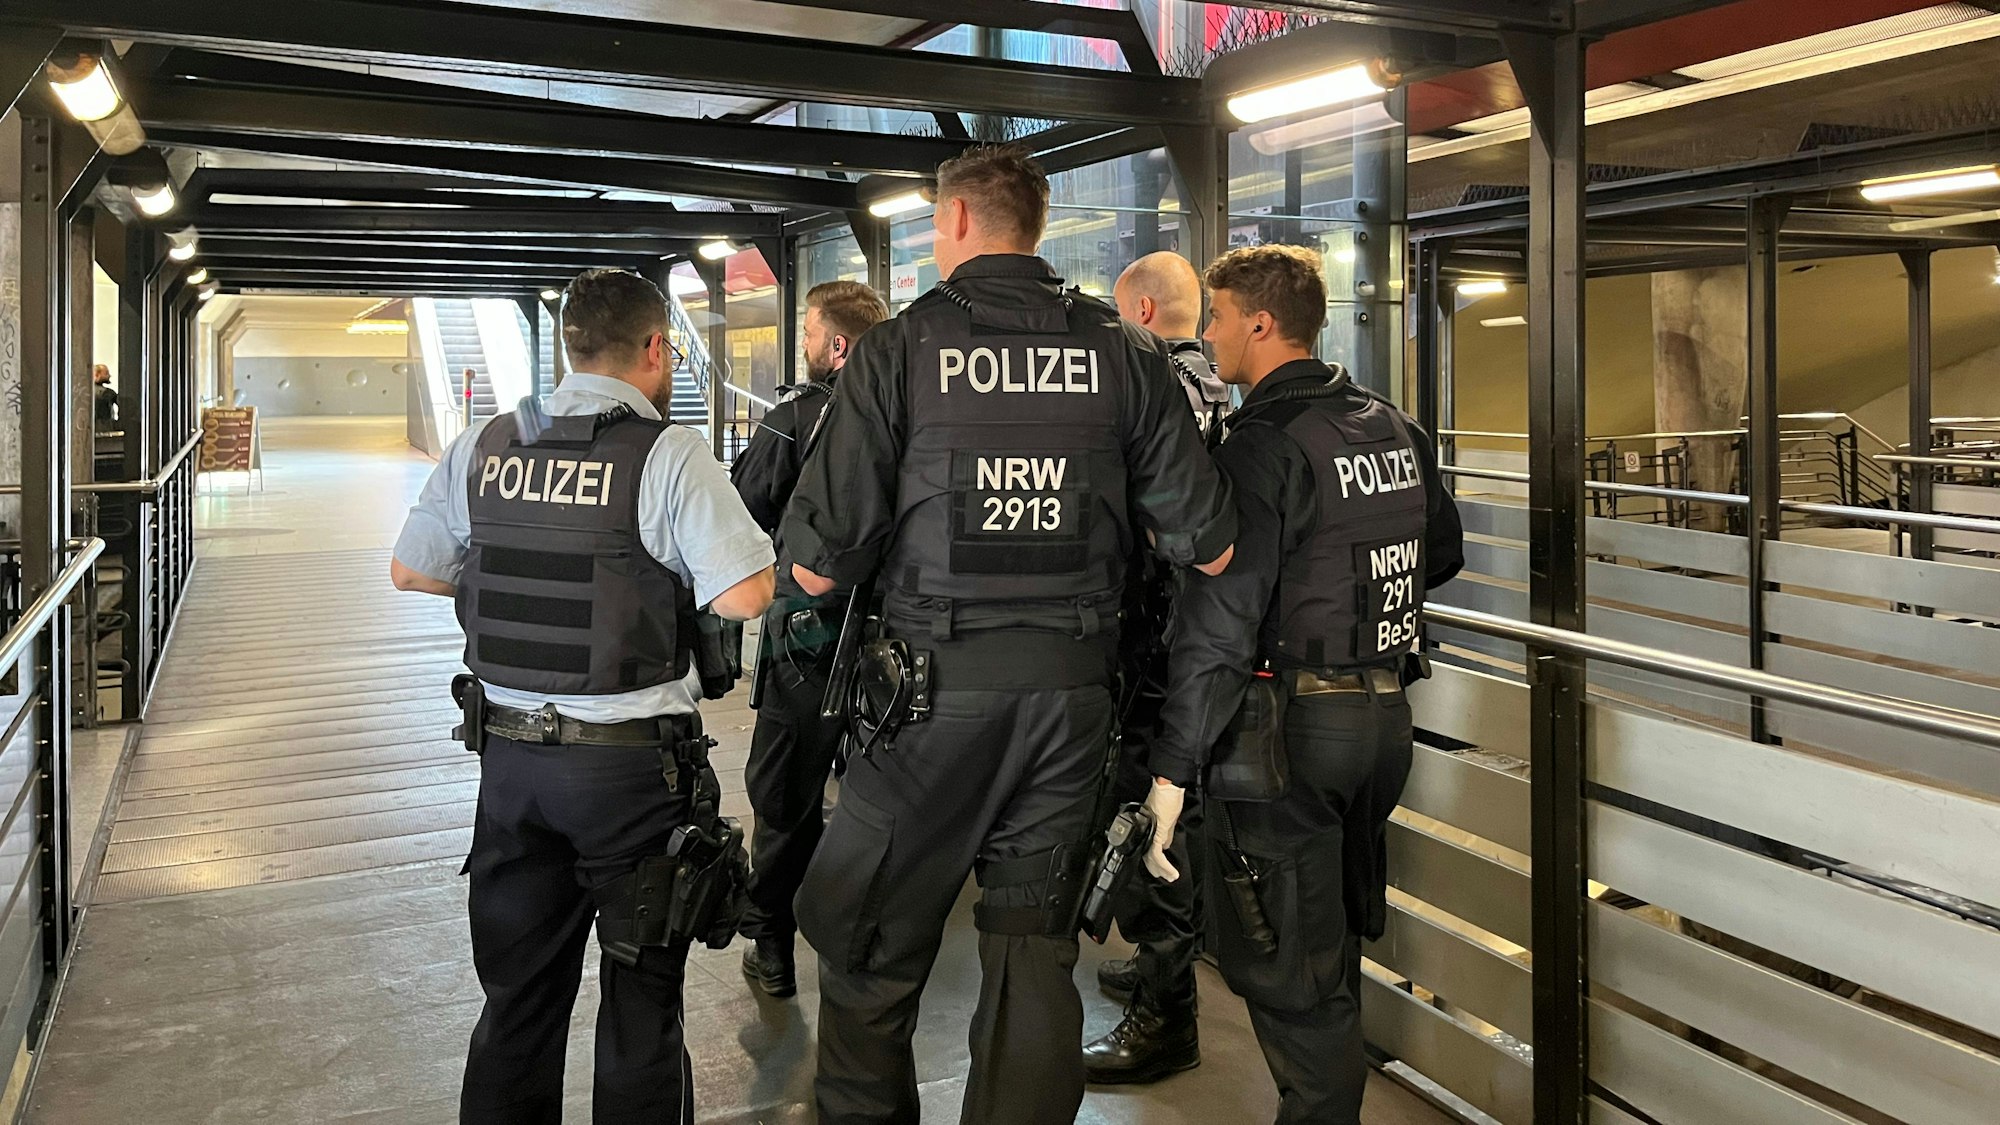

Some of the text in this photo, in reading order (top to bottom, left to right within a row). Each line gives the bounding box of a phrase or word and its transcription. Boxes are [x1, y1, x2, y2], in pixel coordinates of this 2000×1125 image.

[939, 347, 1099, 394] POLIZEI
[478, 456, 614, 507] POLIZEI
[976, 457, 1067, 491] NRW
[1333, 447, 1421, 499] POLIZEI
[982, 496, 1062, 531] 2913
[1369, 538, 1419, 580] NRW
[1382, 574, 1413, 613] 291
[1377, 609, 1418, 652] BeSi
